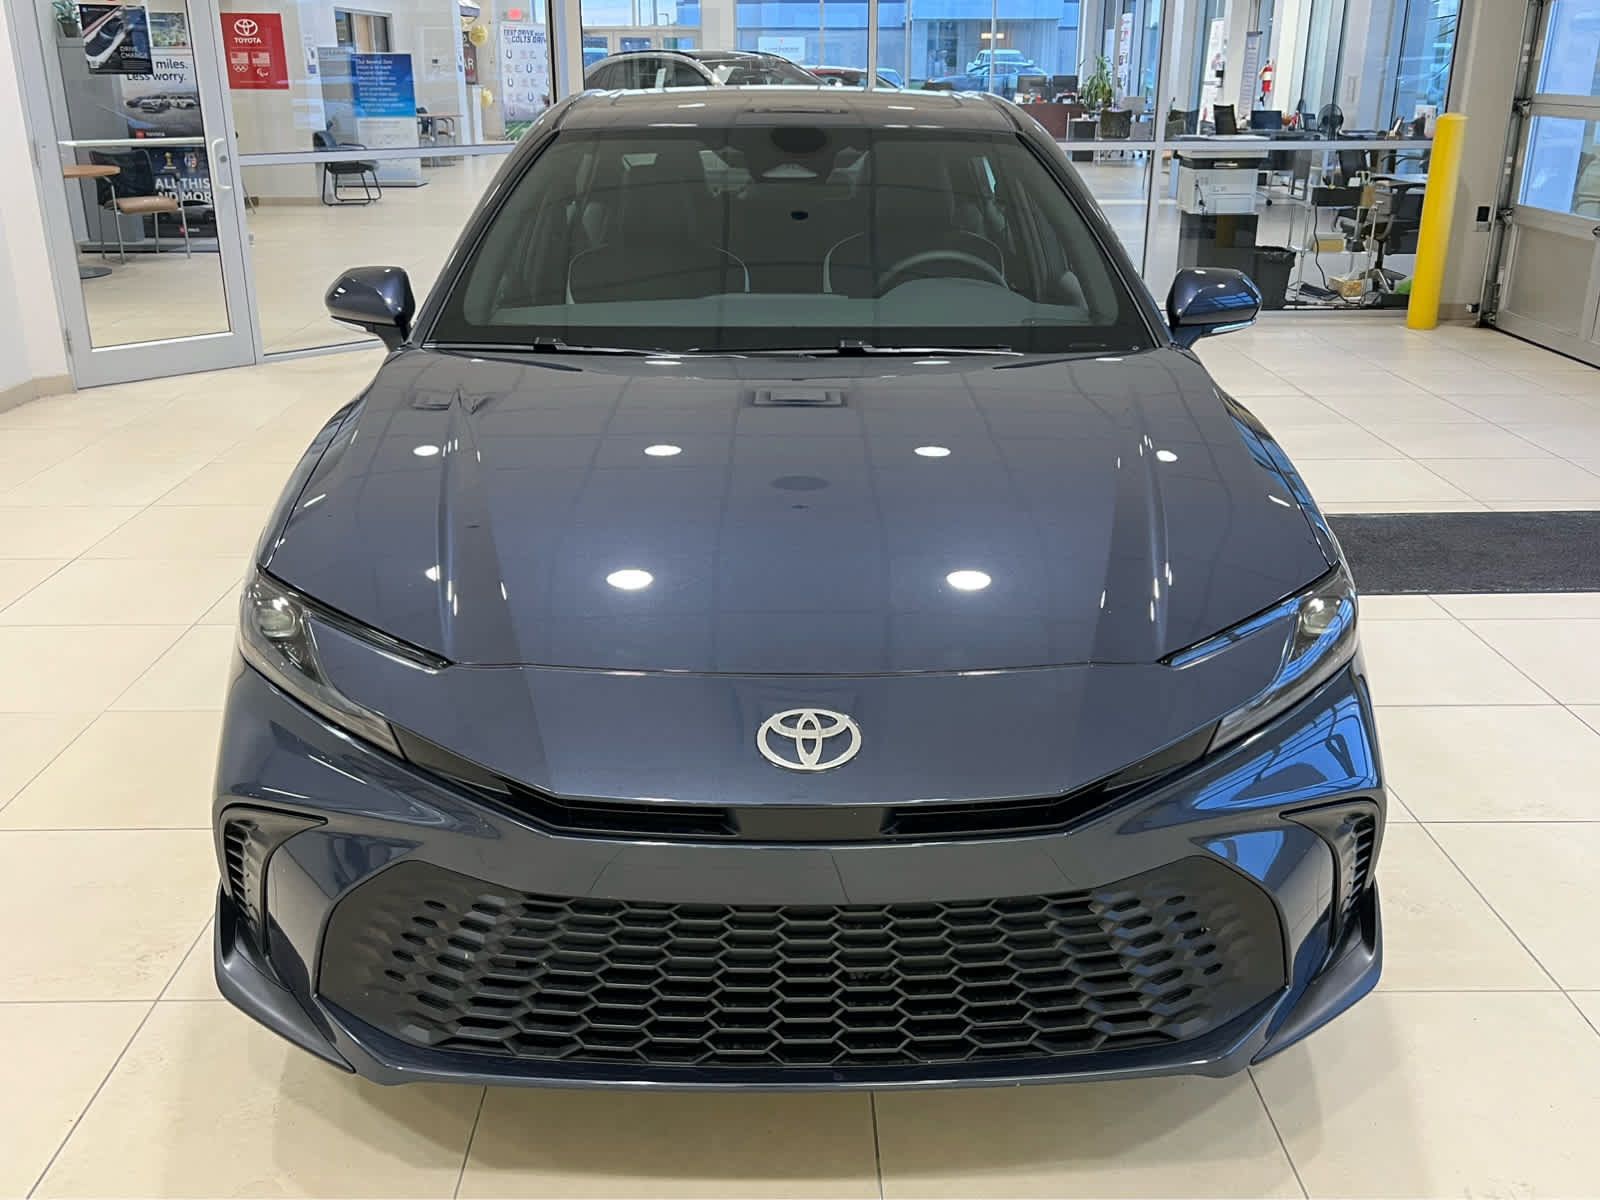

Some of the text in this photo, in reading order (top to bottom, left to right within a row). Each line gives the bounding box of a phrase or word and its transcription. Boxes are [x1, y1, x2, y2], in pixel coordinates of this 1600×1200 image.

[233, 36, 262, 44] TOYOTA
[155, 59, 189, 69] miles.
[152, 72, 186, 83] worry.
[155, 178, 210, 190] ALL THIS
